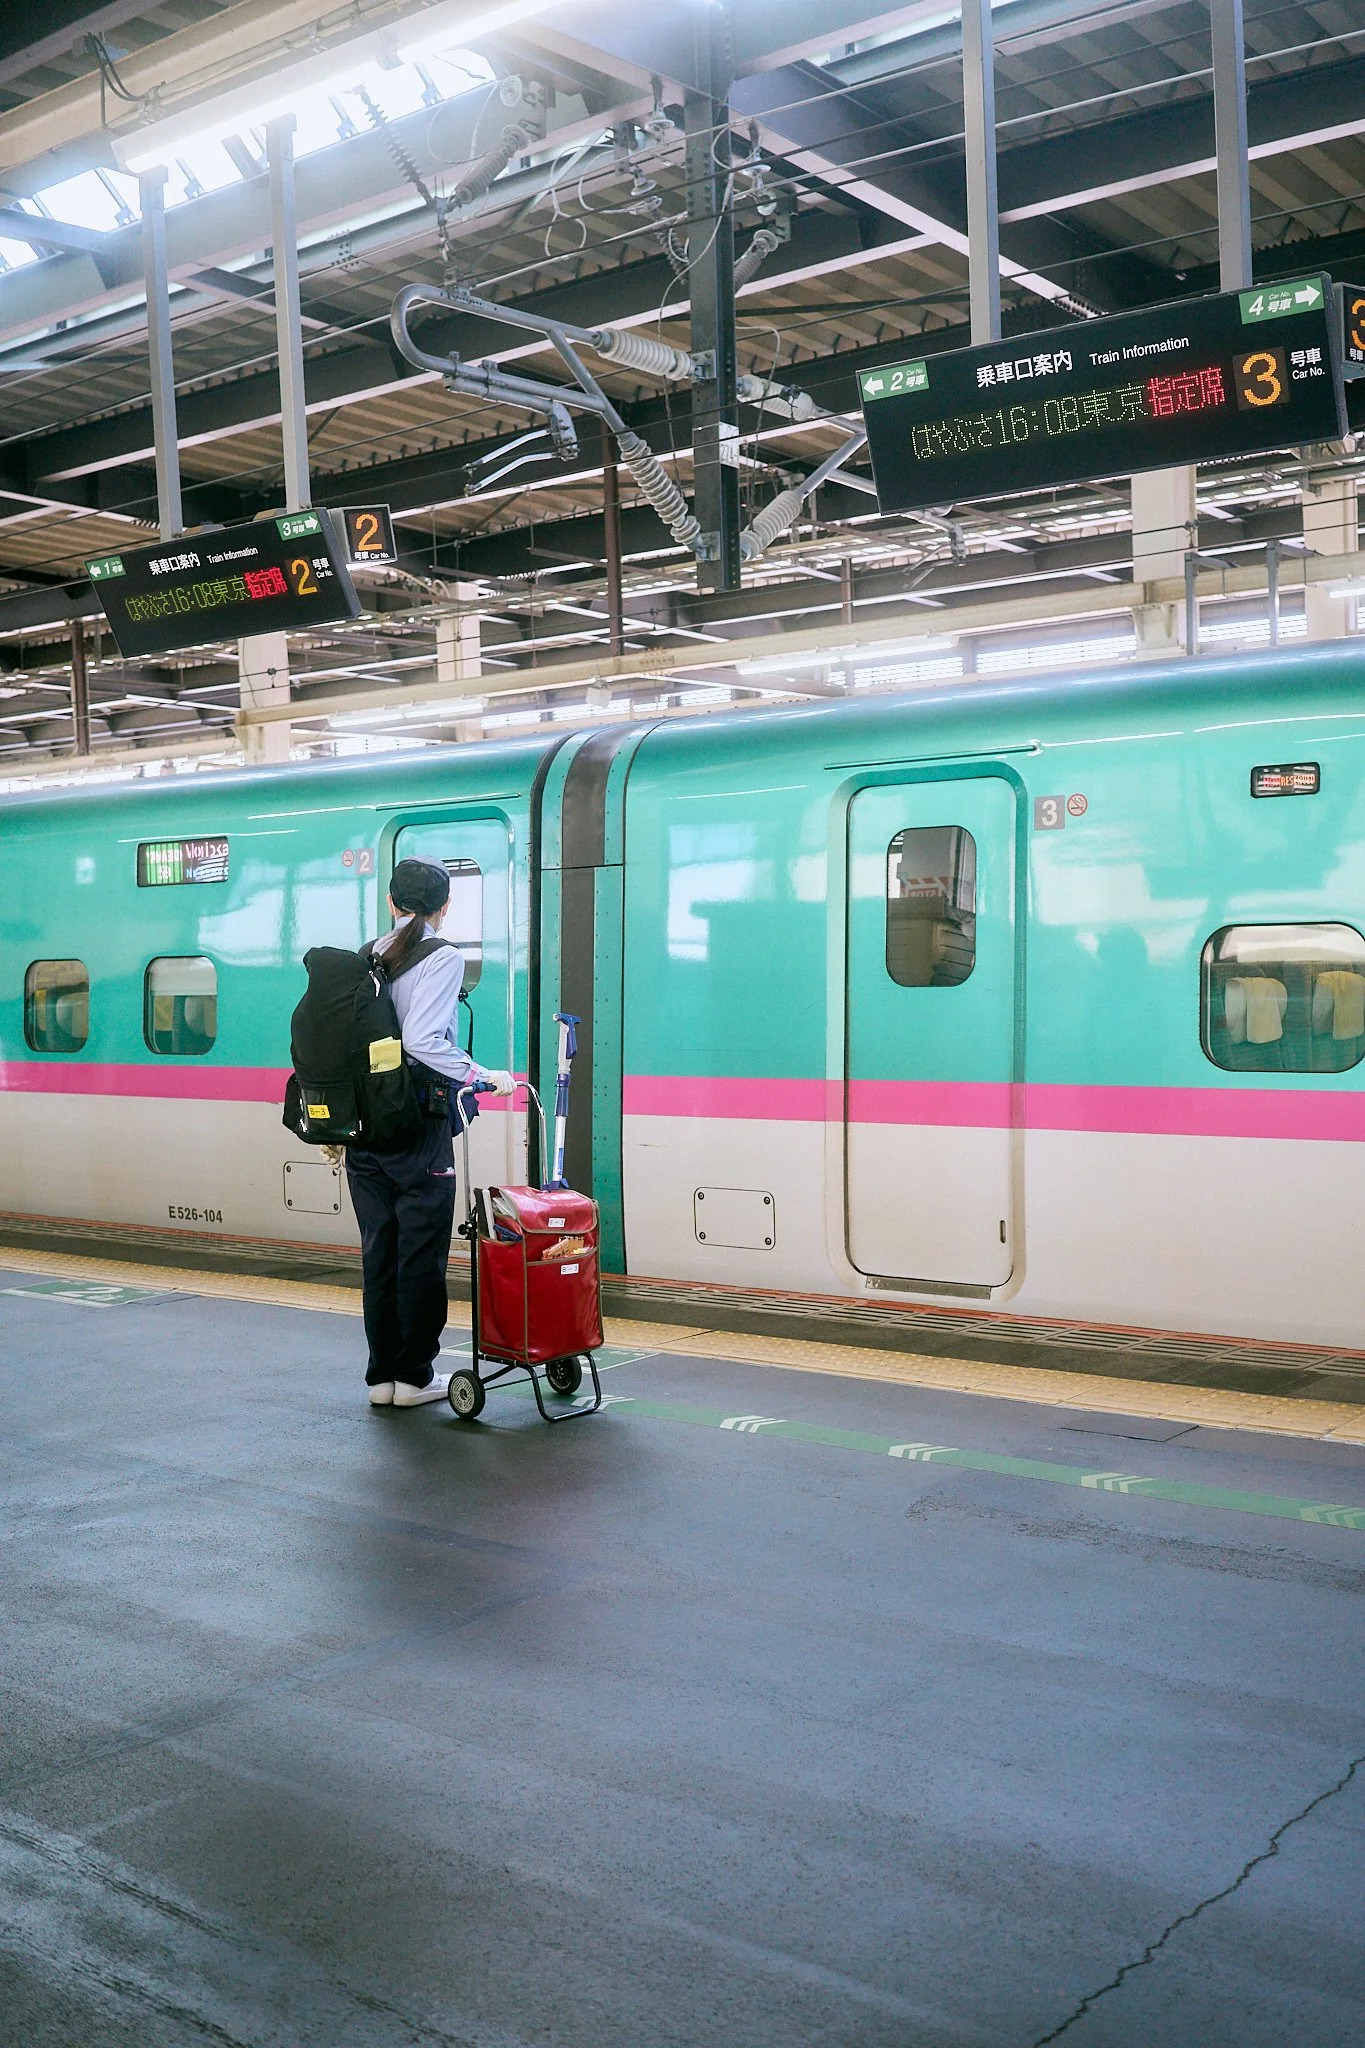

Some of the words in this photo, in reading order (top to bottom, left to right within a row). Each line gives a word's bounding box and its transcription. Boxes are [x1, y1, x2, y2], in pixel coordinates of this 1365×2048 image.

[1248, 295, 1264, 316] 4
[1267, 298, 1292, 313] 号車
[976, 349, 1073, 389] 乗車口案内
[1089, 350, 1120, 366] Train
[1122, 337, 1190, 360] Information
[1290, 347, 1322, 367] 号車
[890, 371, 904, 391] 2
[906, 374, 926, 388] 号車
[1242, 352, 1282, 406] 3
[1292, 369, 1308, 380] Car
[1309, 367, 1326, 377] No.
[282, 522, 291, 536] 3
[355, 513, 383, 551] 2
[149, 551, 201, 576] 乗車口案内
[206, 555, 224, 565] Train
[224, 547, 259, 561] Information
[370, 552, 380, 560] Car
[104, 562, 110, 575] 1
[291, 559, 318, 595] 2
[1041, 799, 1058, 827] 3
[359, 851, 370, 872] 2
[168, 1206, 223, 1223] E526-104
